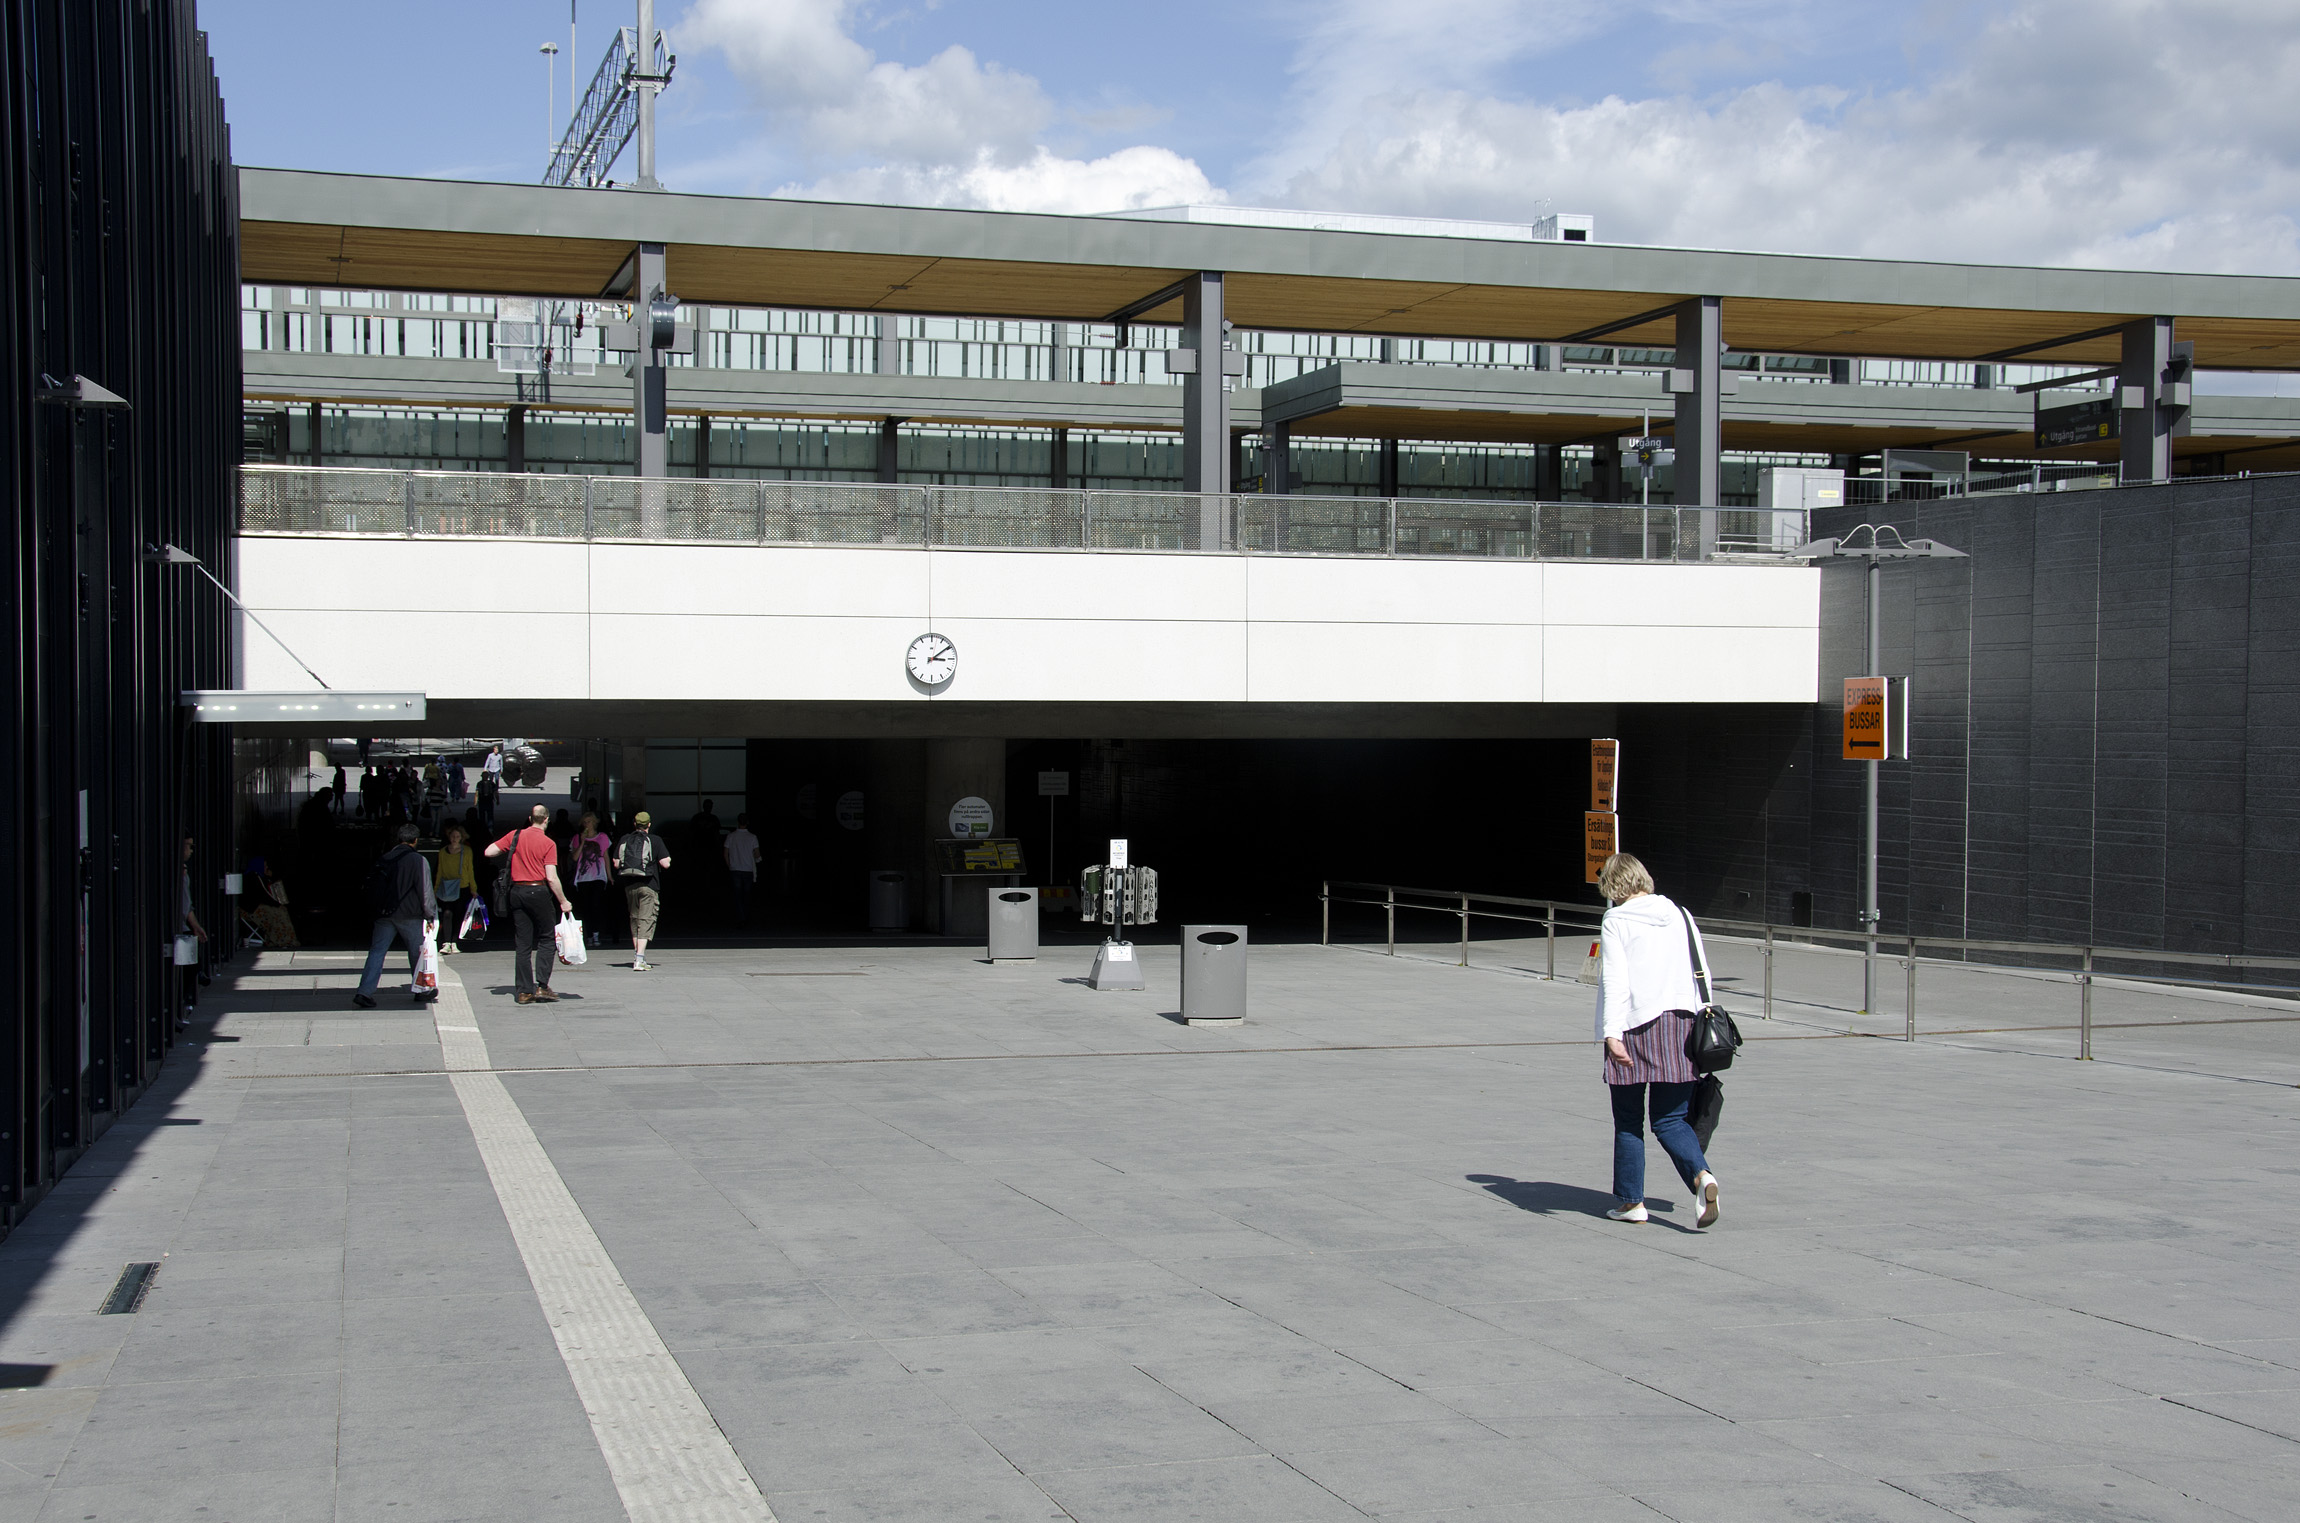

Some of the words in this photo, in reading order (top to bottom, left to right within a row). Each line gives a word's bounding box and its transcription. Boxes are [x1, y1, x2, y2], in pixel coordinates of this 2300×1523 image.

[1628, 437, 1662, 449] Utgång
[2050, 429, 2075, 443] Utgång
[1847, 687, 1883, 705] EXPRESS-
[1849, 712, 1880, 729] BUSSAR
